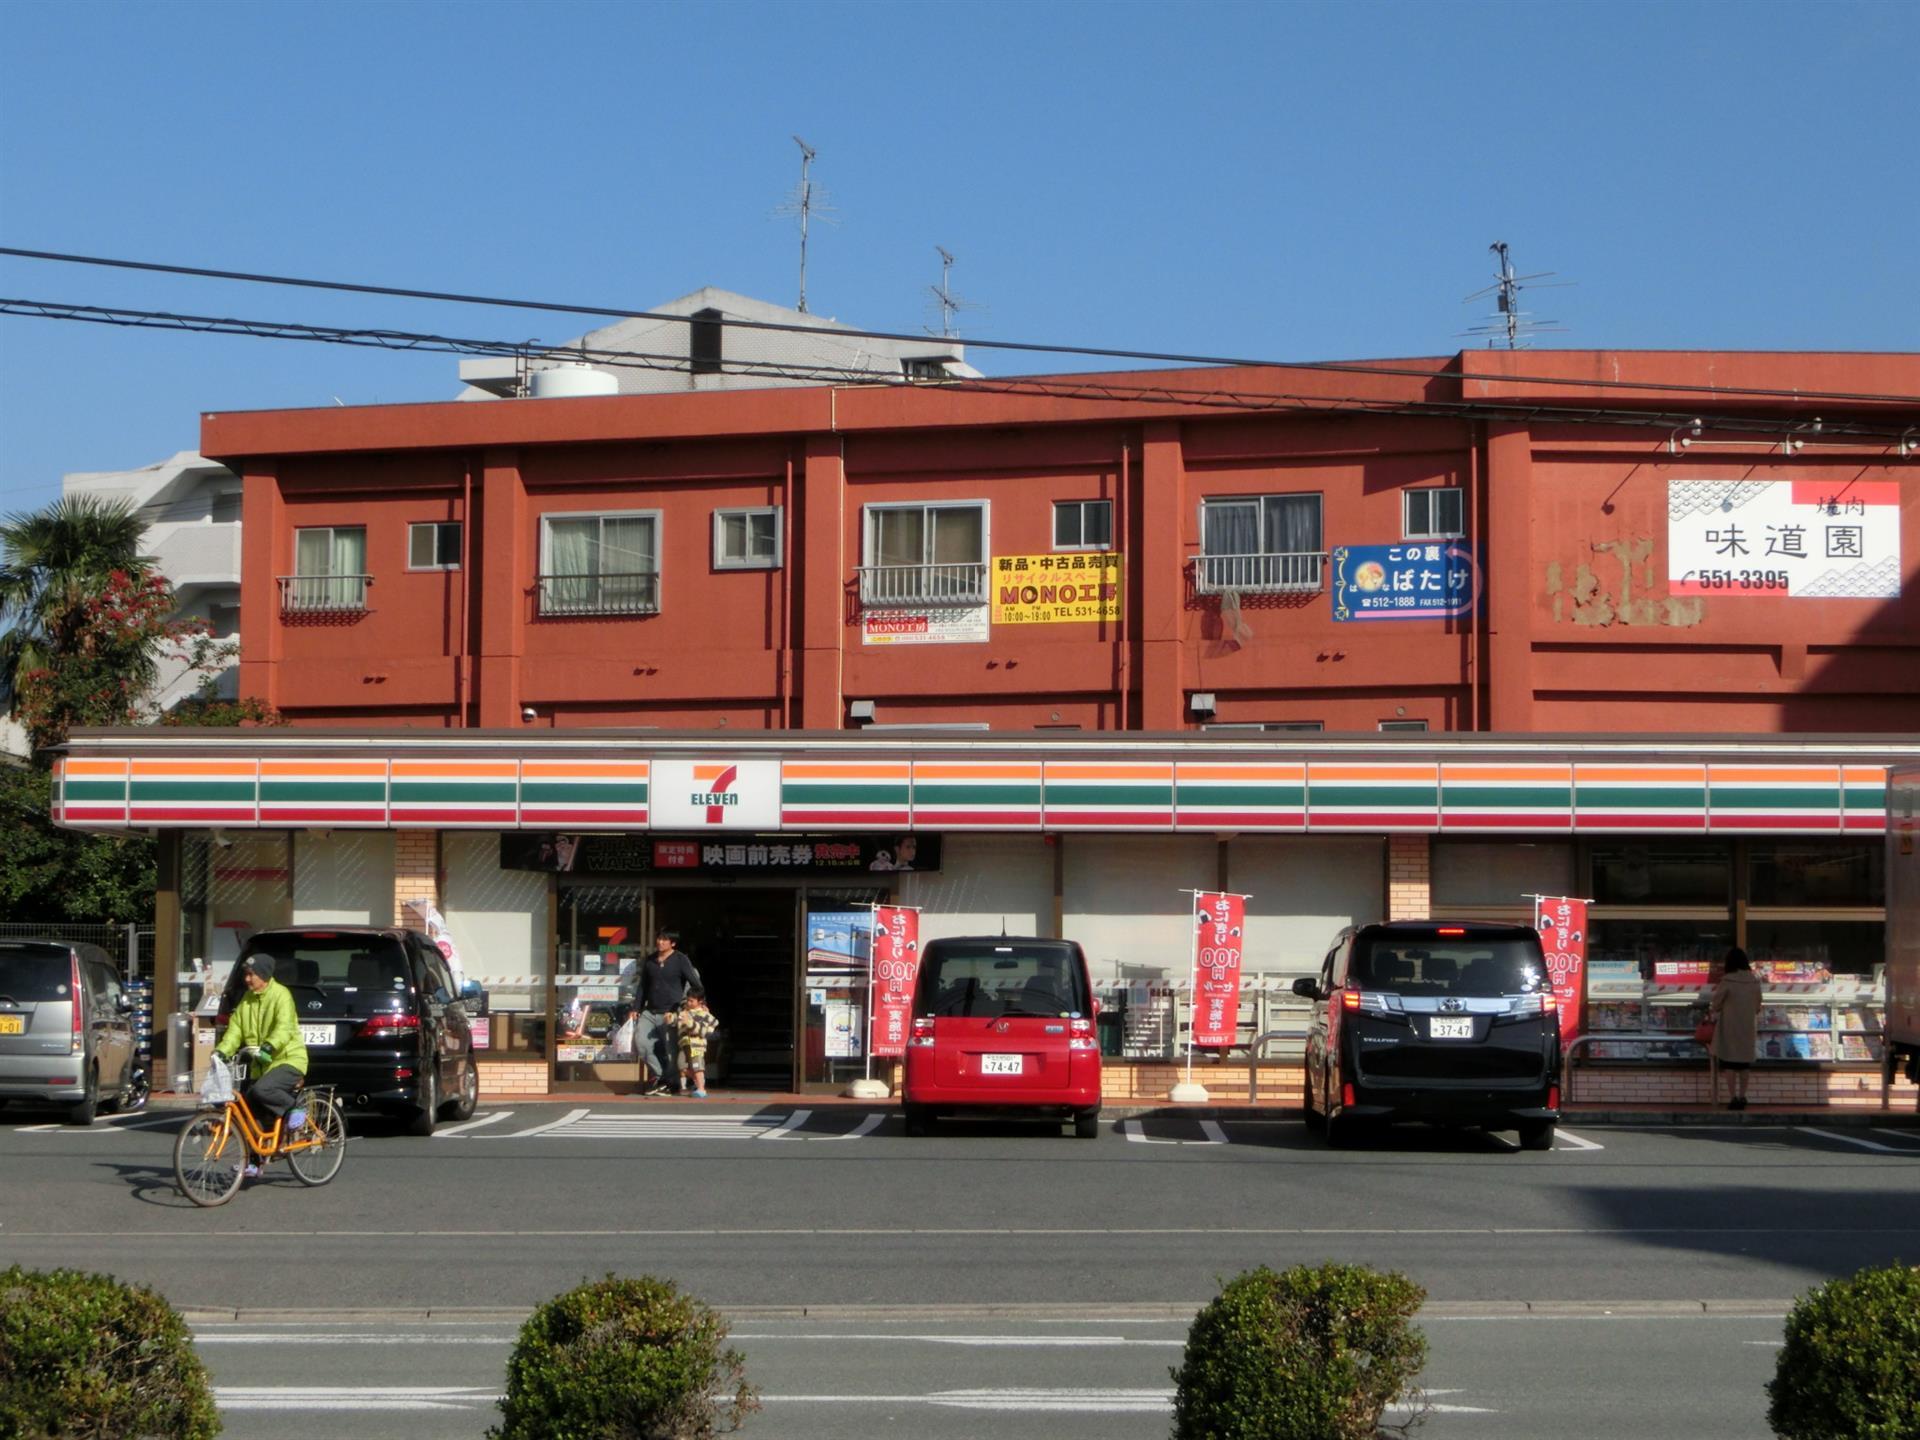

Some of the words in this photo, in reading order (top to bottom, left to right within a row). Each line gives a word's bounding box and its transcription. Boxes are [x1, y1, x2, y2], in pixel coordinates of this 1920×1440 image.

[1705, 523, 1863, 559] 味道園
[1389, 546, 1440, 561] この裏
[999, 555, 1119, 572] 新品・中古品売買
[1699, 569, 1789, 590] 551-3395
[1372, 596, 1415, 608] 512-1888
[1054, 607, 1072, 617] TEL
[1075, 606, 1120, 617] 531-4658
[693, 765, 737, 823] 7
[703, 844, 813, 867] 映画前売券
[1440, 1025, 1470, 1037] 37-47
[991, 1061, 1020, 1073] 74-47
